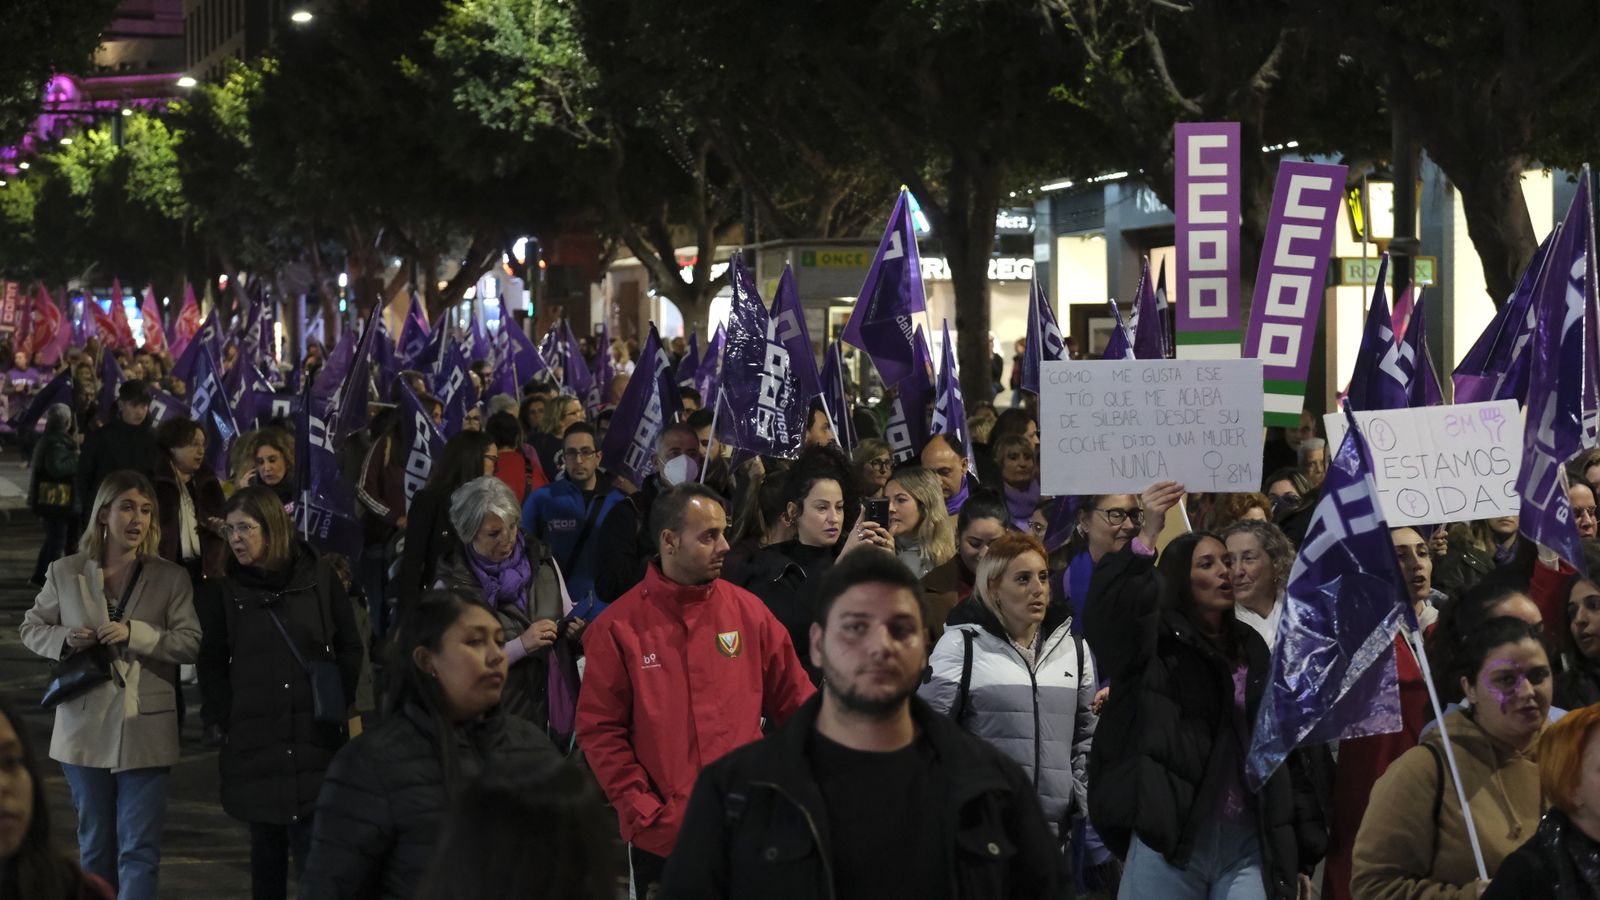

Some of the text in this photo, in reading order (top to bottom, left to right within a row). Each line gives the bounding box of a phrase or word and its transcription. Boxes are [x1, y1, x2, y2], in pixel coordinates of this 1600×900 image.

[1187, 134, 1229, 319] CCOO
[822, 253, 864, 266] ONCE
[1257, 174, 1333, 368] CCOO
[1349, 264, 1428, 279] ROX
[1112, 369, 1132, 383] ME
[1142, 367, 1182, 384] GUSTA
[1196, 366, 1224, 382] ESE
[1104, 390, 1135, 408] QUE
[1145, 389, 1167, 408] ME
[1178, 387, 1223, 407] ACABA
[1060, 414, 1081, 429] DE
[1156, 409, 1207, 426] DESDE
[1217, 408, 1240, 425] SU
[1168, 431, 1196, 448] UNA
[1202, 427, 1248, 448] MUJER
[1110, 449, 1252, 484] NUNCA 8M
[1383, 446, 1511, 480] ESTAMOS
